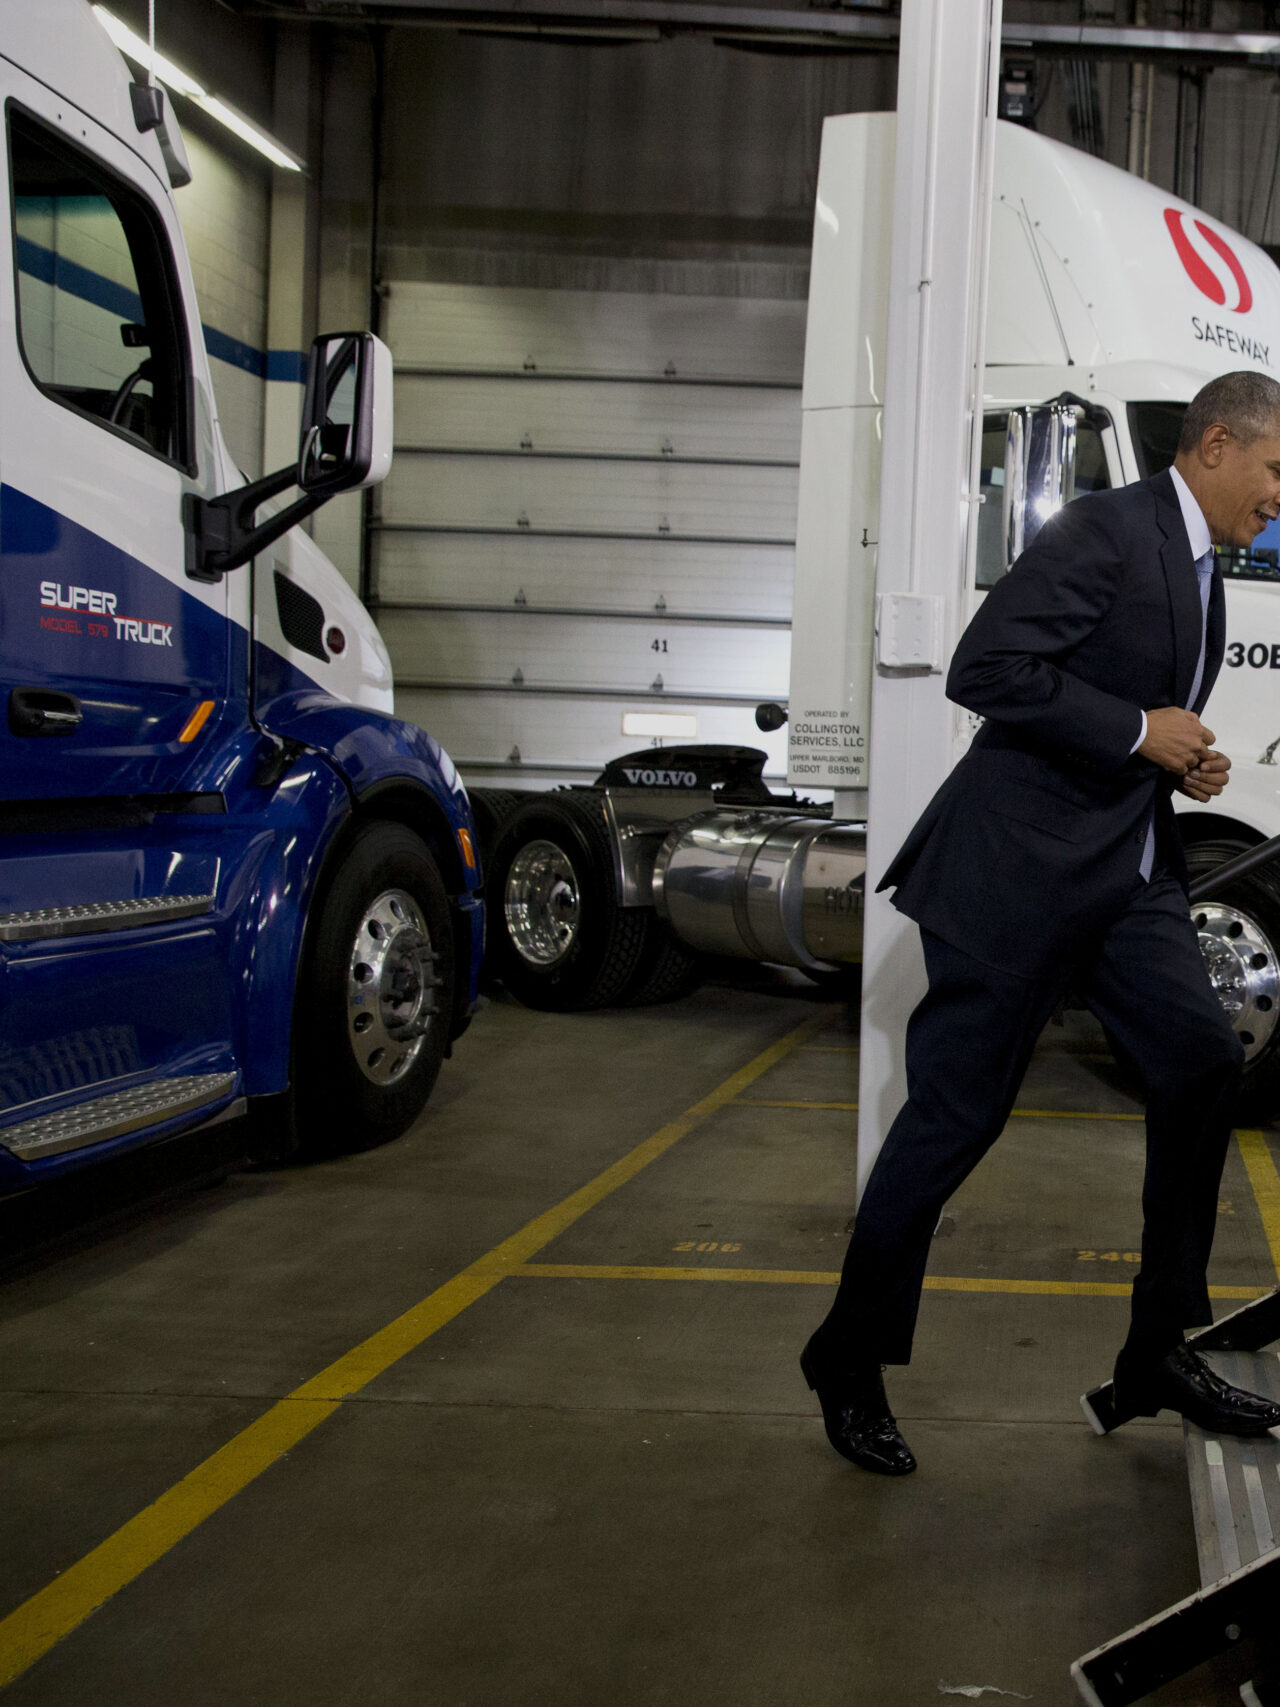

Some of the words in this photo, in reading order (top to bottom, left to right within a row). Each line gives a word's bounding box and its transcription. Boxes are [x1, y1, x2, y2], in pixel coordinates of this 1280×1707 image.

[1192, 316, 1270, 366] SAFEWAY
[40, 580, 117, 615] SUPER
[40, 616, 82, 634] MODEL
[88, 623, 109, 638] 579
[113, 617, 173, 647] TRUCK
[651, 638, 668, 653] 41
[804, 710, 838, 718] OPERATED
[794, 723, 860, 735] COLLINGTON
[790, 735, 841, 747] SERVICES,
[843, 737, 864, 747] LLC
[793, 765, 821, 774] USDOT
[622, 769, 697, 787] VOLVO
[672, 1241, 742, 1252] 206
